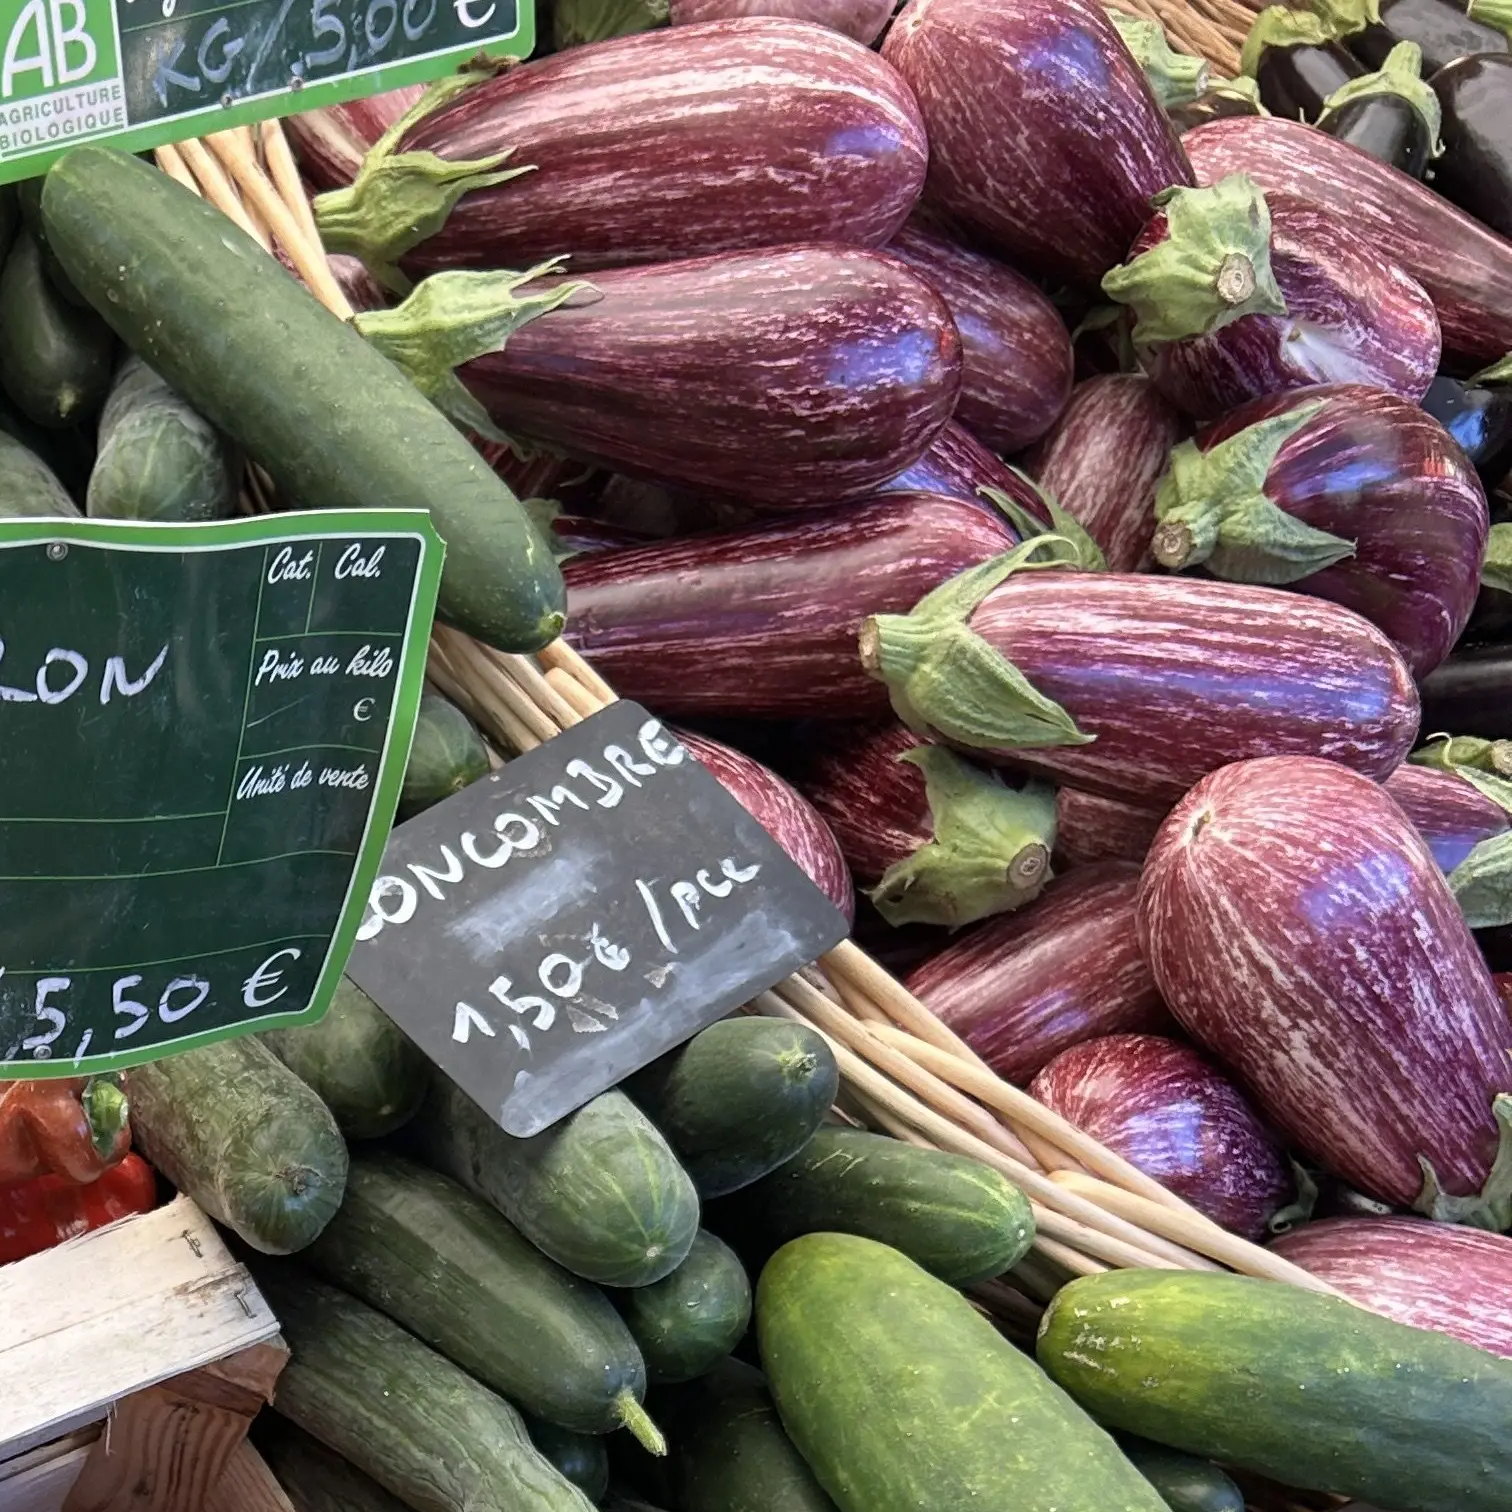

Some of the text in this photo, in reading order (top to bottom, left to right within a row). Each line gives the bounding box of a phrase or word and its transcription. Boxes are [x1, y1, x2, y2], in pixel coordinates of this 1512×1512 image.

[1, 0, 97, 98] AB
[0, 107, 124, 150] BIOLOGIQUE
[267, 545, 314, 584] Cat.
[334, 543, 386, 580] Cal.
[255, 644, 394, 687] Prix au kilo
[352, 697, 376, 722] €
[236, 761, 370, 800] Unité de vente
[240, 948, 301, 1008] €
